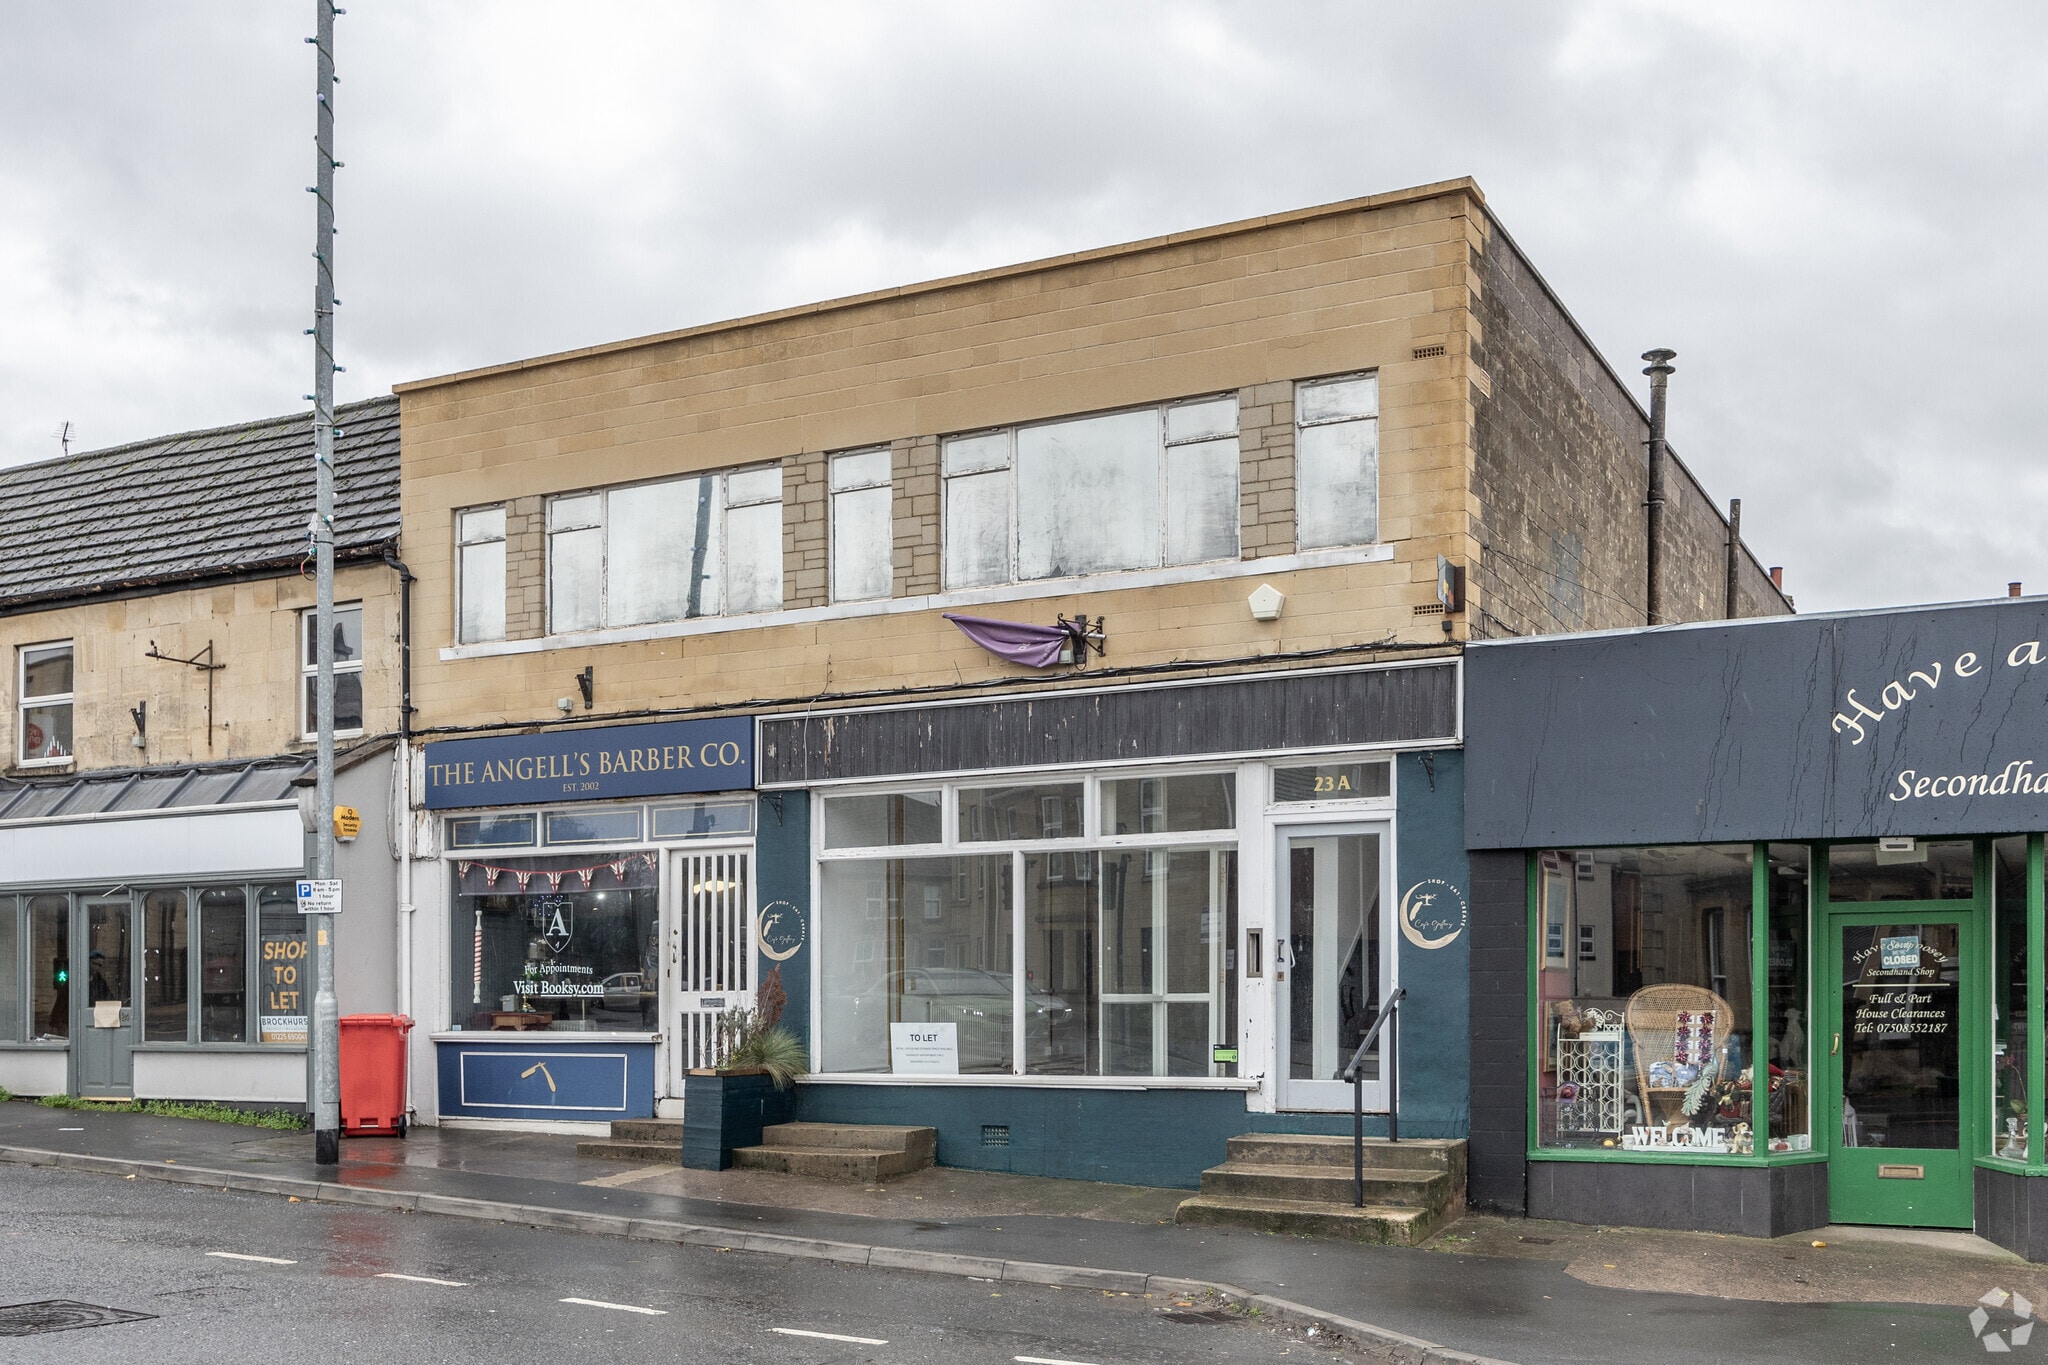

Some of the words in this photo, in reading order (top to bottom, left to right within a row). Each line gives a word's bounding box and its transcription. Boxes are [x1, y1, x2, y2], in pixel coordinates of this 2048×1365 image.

[1832, 651, 1982, 746] Have
[2007, 641, 2046, 667] a
[429, 762, 474, 787] THE
[480, 752, 590, 783] ANGELL'S
[599, 745, 695, 775] BARBER
[701, 741, 745, 767] CO.
[562, 784, 578, 792] EST.
[580, 782, 599, 792] 2002
[1314, 776, 1334, 792] 23
[1337, 775, 1351, 790] A
[546, 908, 569, 936] A
[1883, 955, 1918, 965] CLOSED
[274, 966, 297, 984] TO
[540, 964, 593, 975] Appointments
[1866, 967, 1913, 977] Secondhand
[1914, 967, 1935, 978] Shop
[513, 981, 538, 994] Visit
[541, 981, 604, 996] Booksy.com
[270, 992, 299, 1010] LET
[1870, 992, 1894, 1003] Full
[1908, 994, 1932, 1003] Part
[1856, 1008, 1888, 1018] House
[1891, 1008, 1945, 1020] Clearances
[1854, 1022, 1874, 1033] Tel:
[1877, 1023, 1948, 1033] 07508552187
[1632, 1126, 1726, 1147] WELCOME
